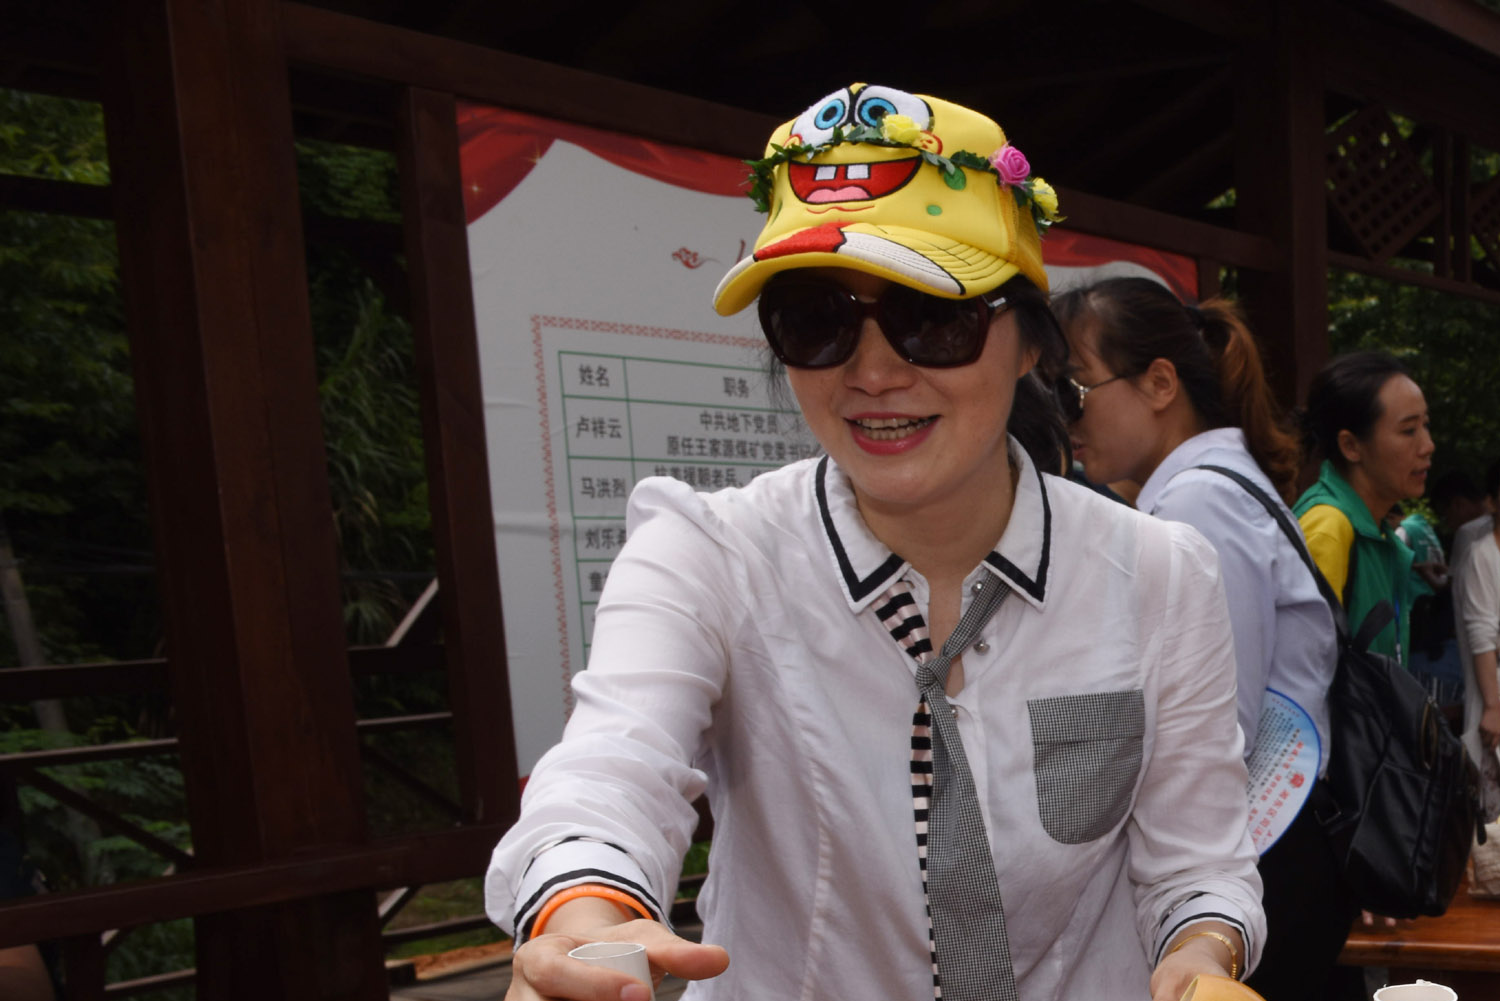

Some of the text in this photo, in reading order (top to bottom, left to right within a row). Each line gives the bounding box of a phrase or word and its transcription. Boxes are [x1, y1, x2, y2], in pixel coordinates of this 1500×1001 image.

[578, 364, 610, 388] 姓名
[722, 376, 750, 399] 职务
[575, 415, 622, 440] 卢祥云
[581, 476, 627, 499] 马洪烈
